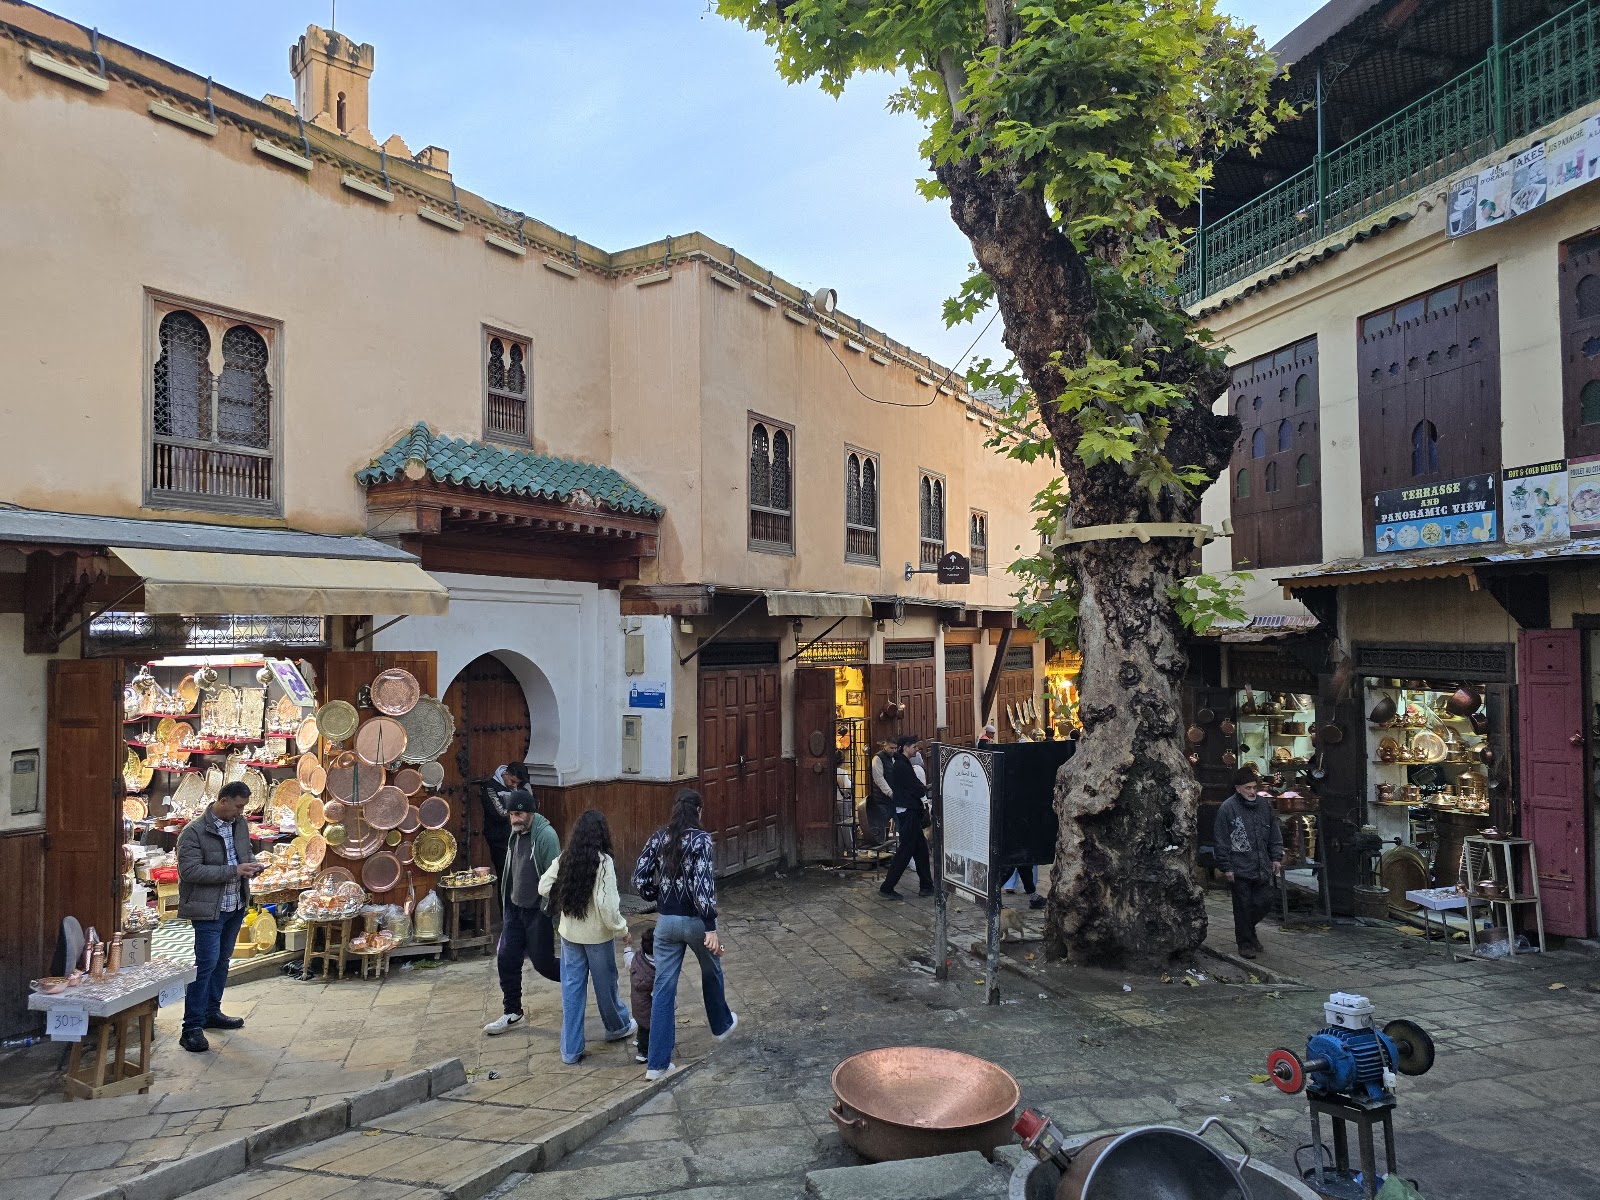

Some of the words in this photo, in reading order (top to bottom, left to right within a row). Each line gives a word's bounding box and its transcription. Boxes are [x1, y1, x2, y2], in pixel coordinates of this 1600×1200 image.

[1508, 469, 1519, 478] HOT
[1525, 466, 1539, 475] COLD
[1540, 463, 1562, 473] DRINKS
[1570, 467, 1585, 476] POULET
[1401, 482, 1461, 500] TERRASSE
[1420, 497, 1440, 507] AND
[1381, 505, 1448, 523] PANORAMIC
[1452, 500, 1487, 514] VIEW
